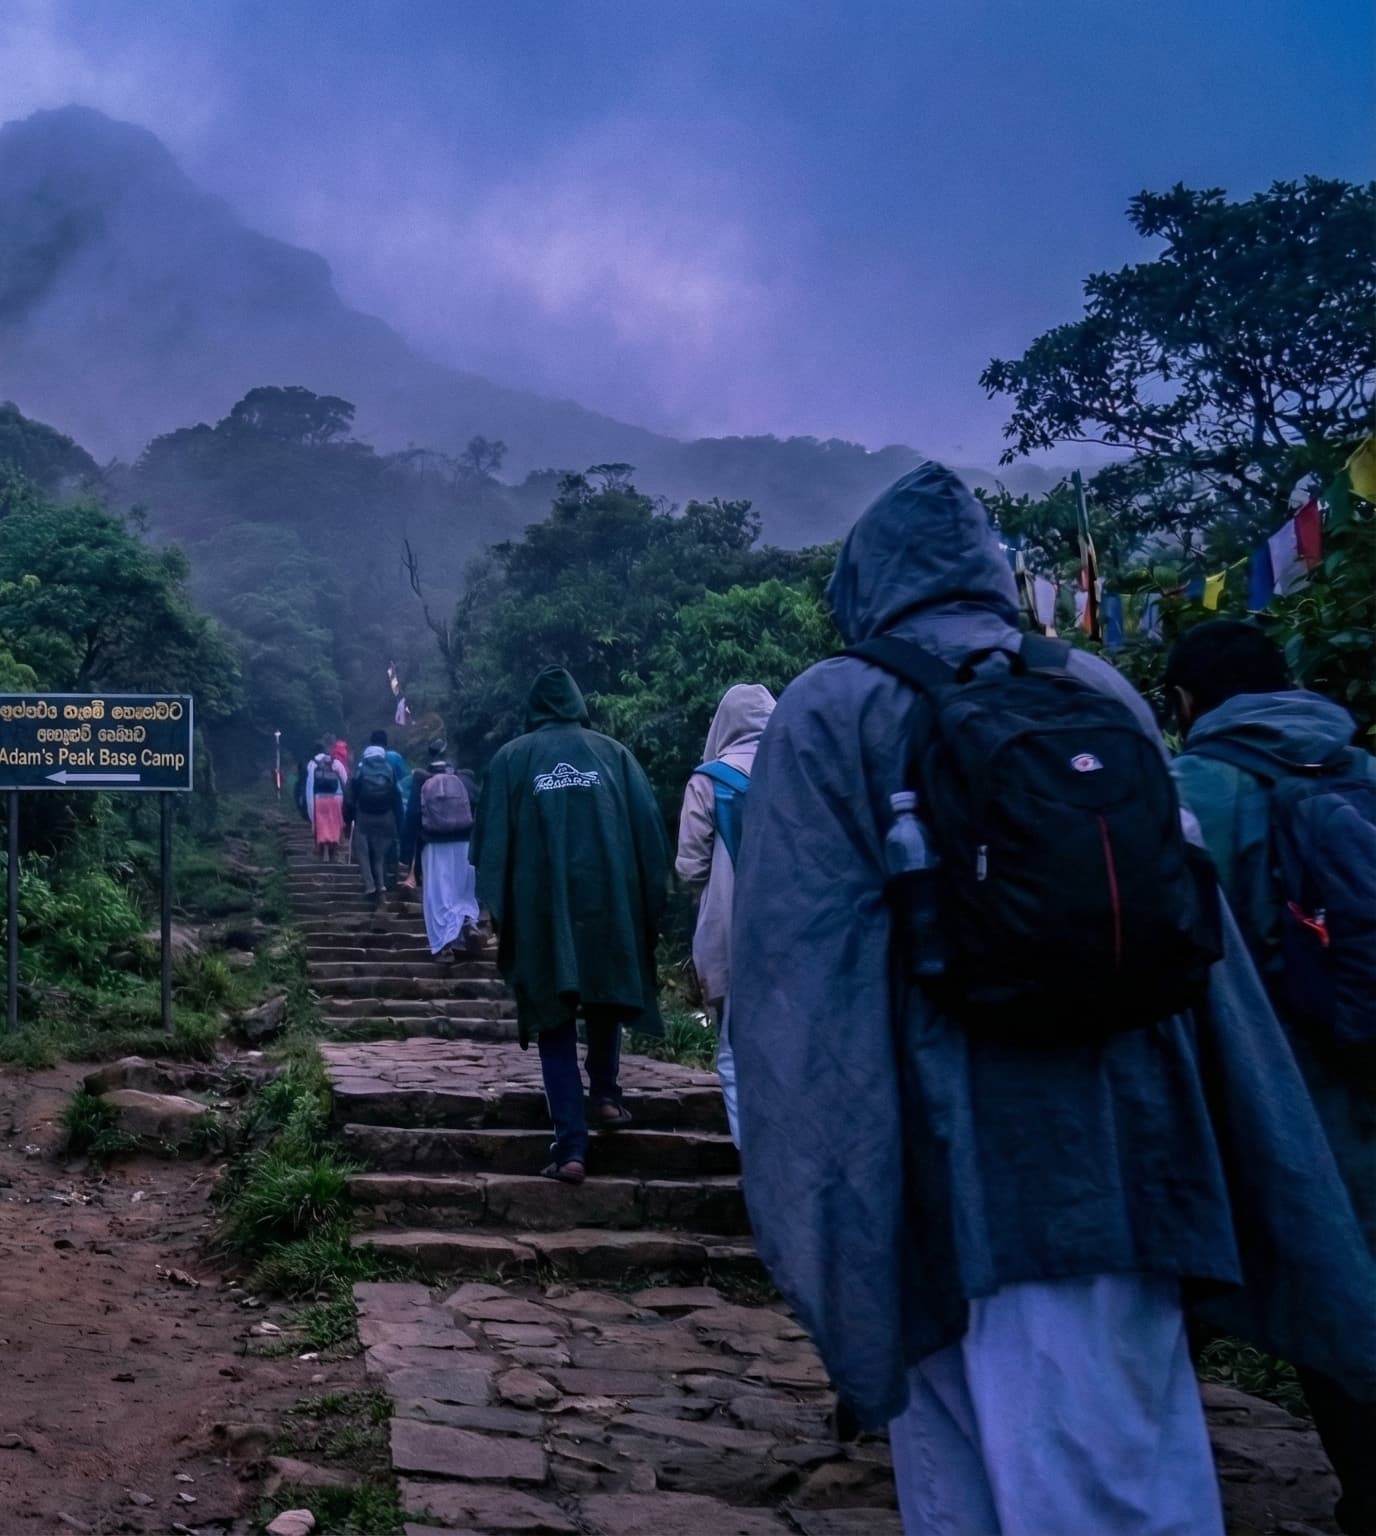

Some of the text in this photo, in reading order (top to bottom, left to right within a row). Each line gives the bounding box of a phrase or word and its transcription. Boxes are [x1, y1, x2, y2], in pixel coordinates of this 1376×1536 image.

[59, 748, 95, 766] Peak
[99, 748, 137, 766] Base
[140, 748, 184, 771] Camp
